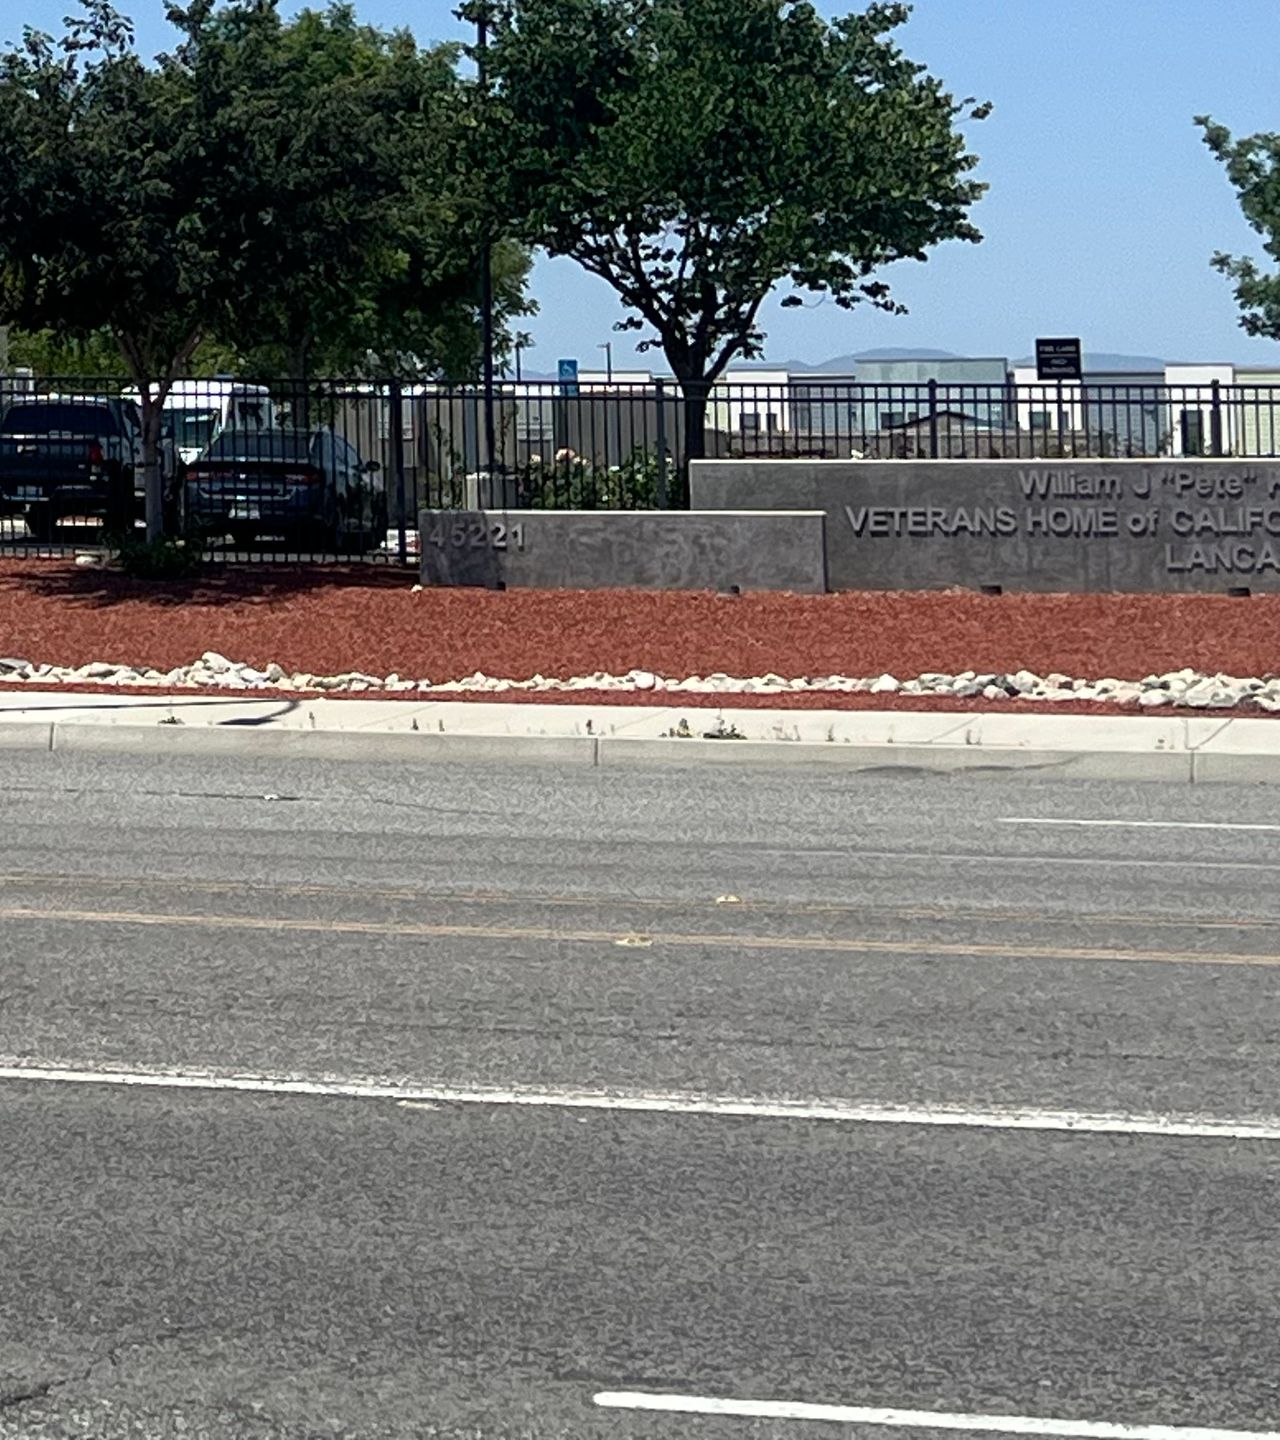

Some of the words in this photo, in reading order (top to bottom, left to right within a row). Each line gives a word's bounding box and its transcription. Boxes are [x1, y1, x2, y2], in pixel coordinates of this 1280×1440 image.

[1018, 469, 1123, 497] William
[1132, 469, 1151, 497] J
[845, 506, 1017, 534] VETERANS
[1026, 507, 1119, 535] HOME
[1127, 507, 1159, 535] of
[429, 523, 524, 549] 45221
[1164, 544, 1280, 573] LANCA
